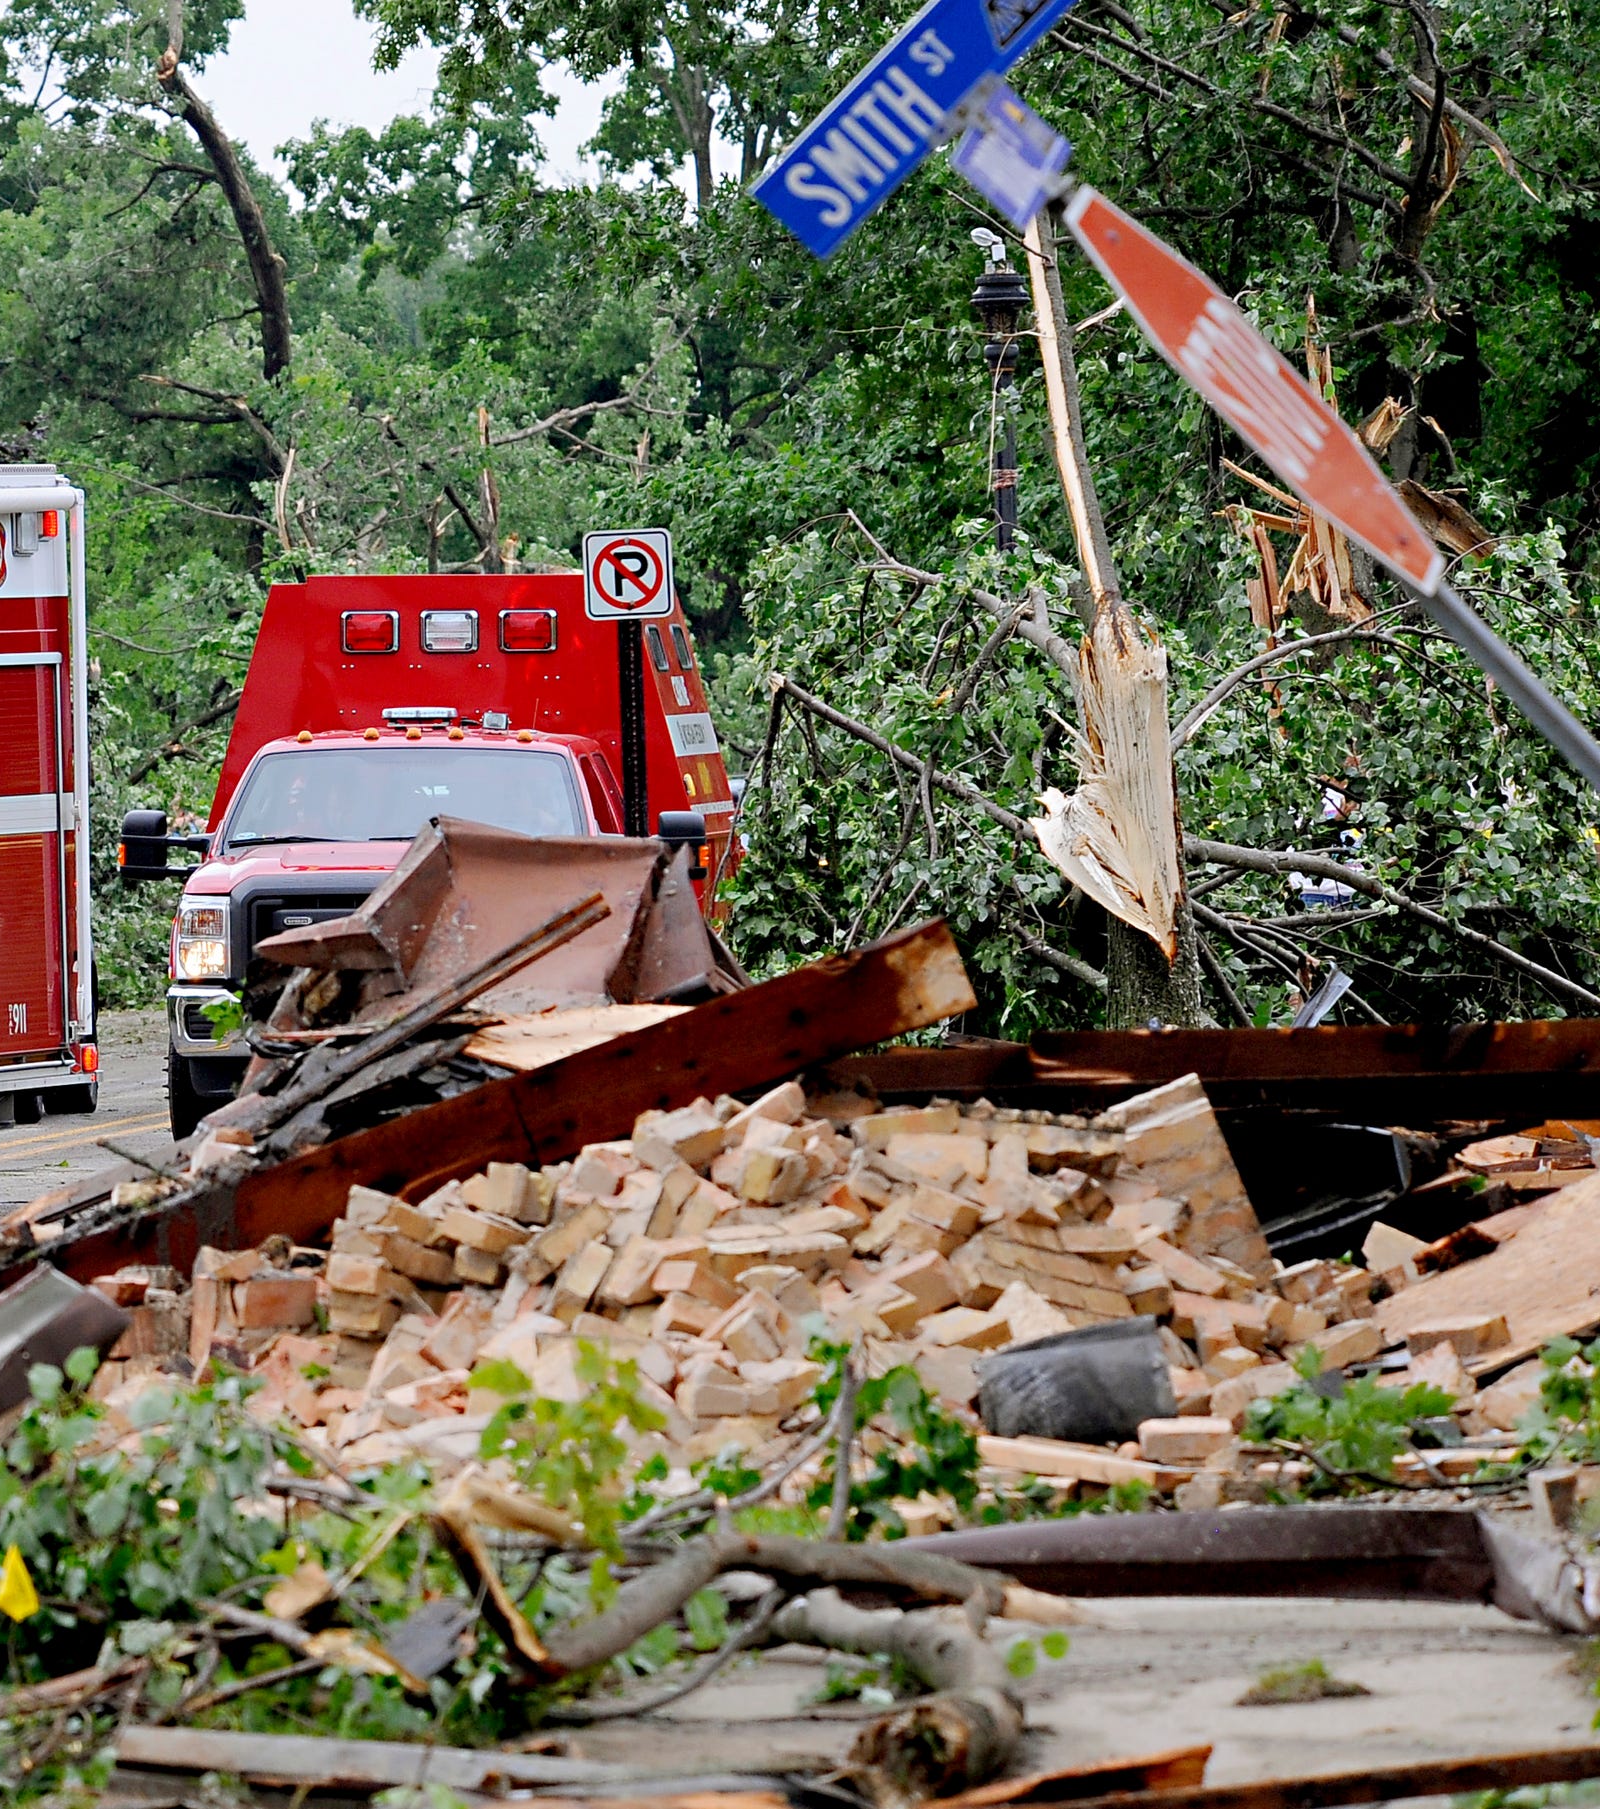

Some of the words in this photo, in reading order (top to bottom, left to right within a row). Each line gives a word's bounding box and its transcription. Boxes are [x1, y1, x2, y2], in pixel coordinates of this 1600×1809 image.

[784, 65, 944, 227] SMITH
[908, 28, 955, 77] ST
[1179, 298, 1330, 481] STOP
[613, 551, 648, 596] P
[12, 1003, 27, 1034] 911
